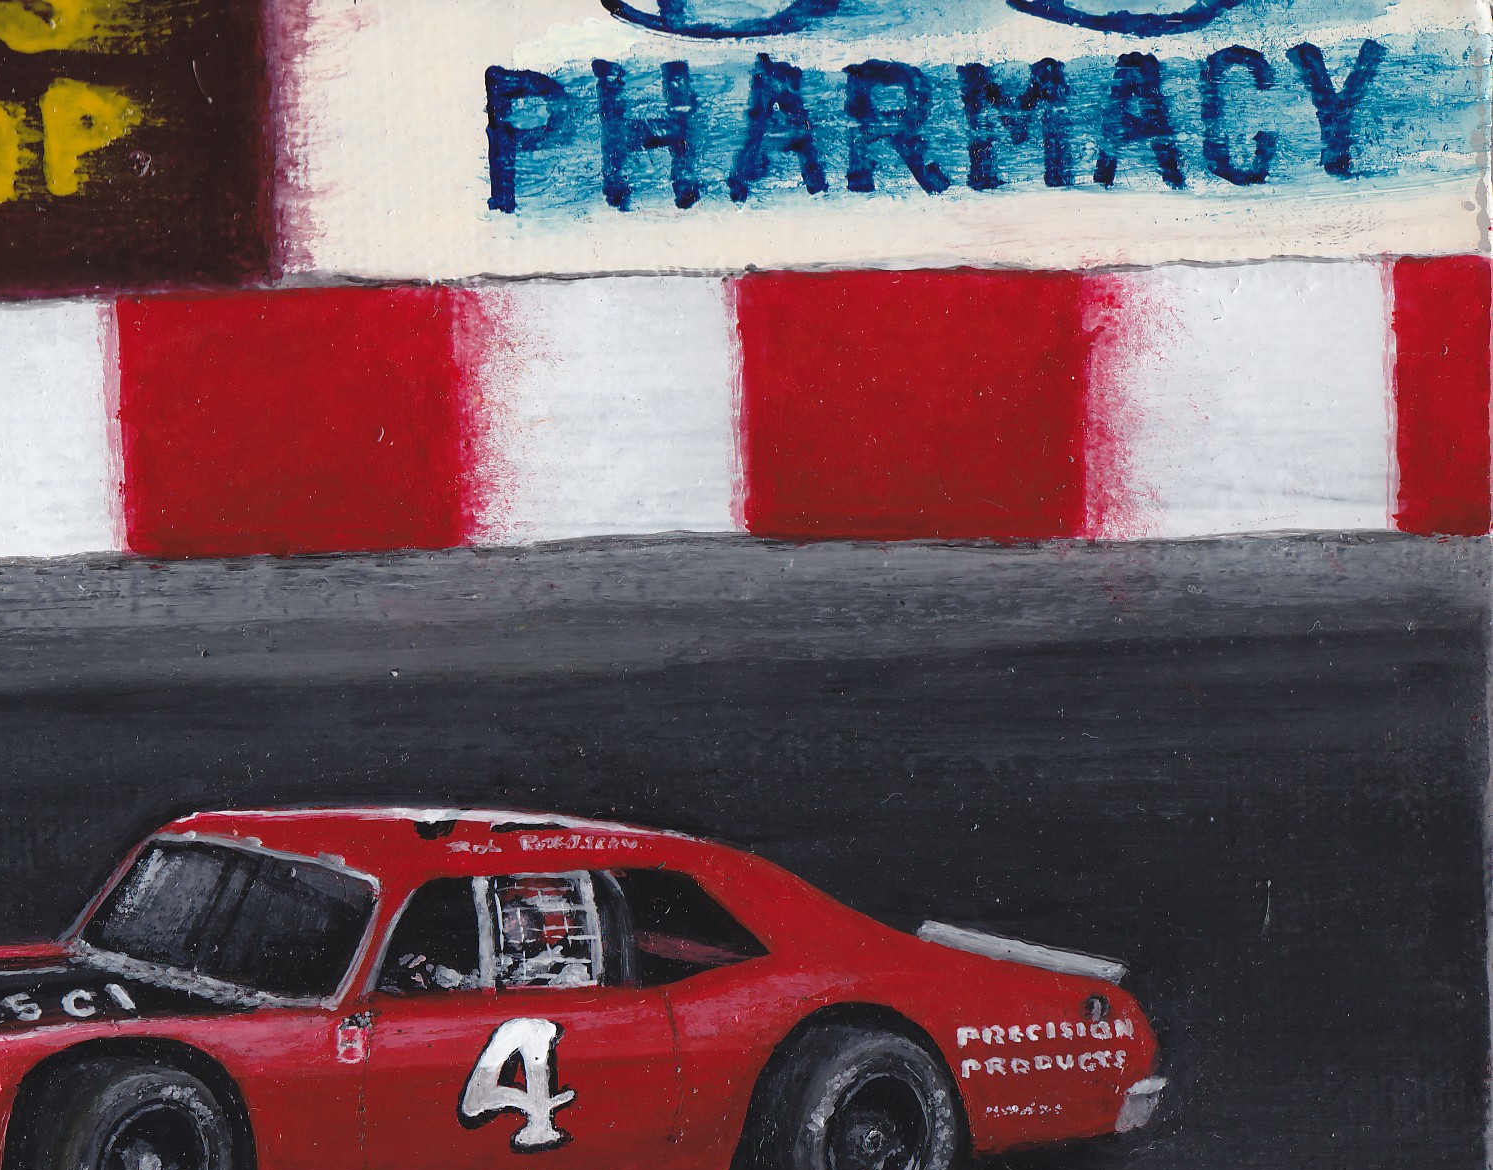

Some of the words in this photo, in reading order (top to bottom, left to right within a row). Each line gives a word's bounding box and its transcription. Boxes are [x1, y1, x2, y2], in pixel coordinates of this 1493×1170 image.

[484, 38, 1383, 213] PHARMACY
[956, 1018, 1135, 1049] PRECISION
[961, 1050, 1128, 1079] PRODUCTS
[457, 1017, 576, 1154] 4
